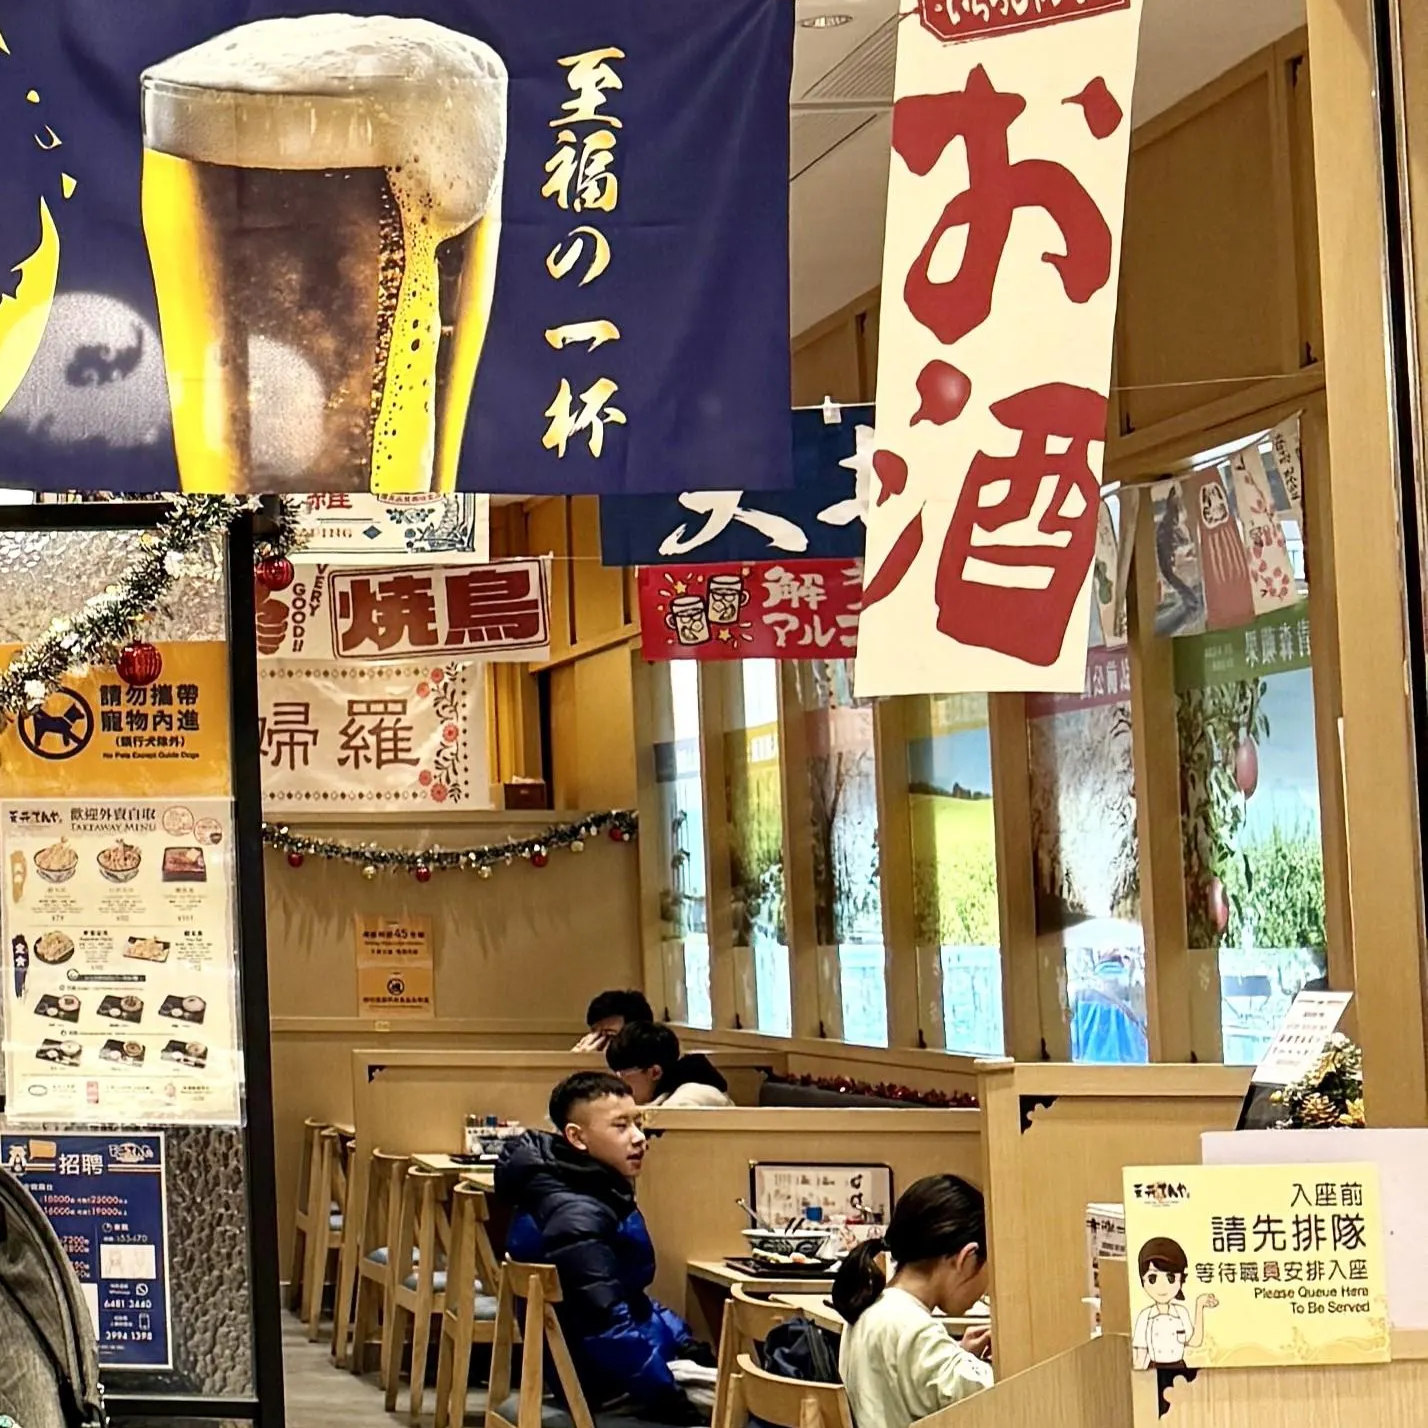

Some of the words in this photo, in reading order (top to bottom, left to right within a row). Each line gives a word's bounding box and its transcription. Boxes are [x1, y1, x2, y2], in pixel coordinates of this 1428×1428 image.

[539, 45, 628, 460] 至福の一杯
[861, 62, 1123, 666] お酒
[309, 563, 329, 617] VERY
[761, 565, 865, 611] 解
[291, 583, 306, 652] GOOD!!
[338, 567, 542, 653] 焼鳥
[100, 684, 199, 706] 請勿攜帶
[70, 822, 122, 832] TAKEAWAY
[124, 822, 156, 832] MENU
[58, 1153, 104, 1175] 招聘
[1290, 1182, 1363, 1207] 入座前
[1211, 1213, 1367, 1253] 請先排隊
[1195, 1258, 1369, 1284] 等待職員安排入座
[1253, 1286, 1295, 1300] Please
[1298, 1286, 1338, 1300] Queue
[1340, 1286, 1369, 1299] Here
[1290, 1300, 1305, 1313] To
[1307, 1300, 1324, 1314] Be
[1327, 1300, 1370, 1314] Served
